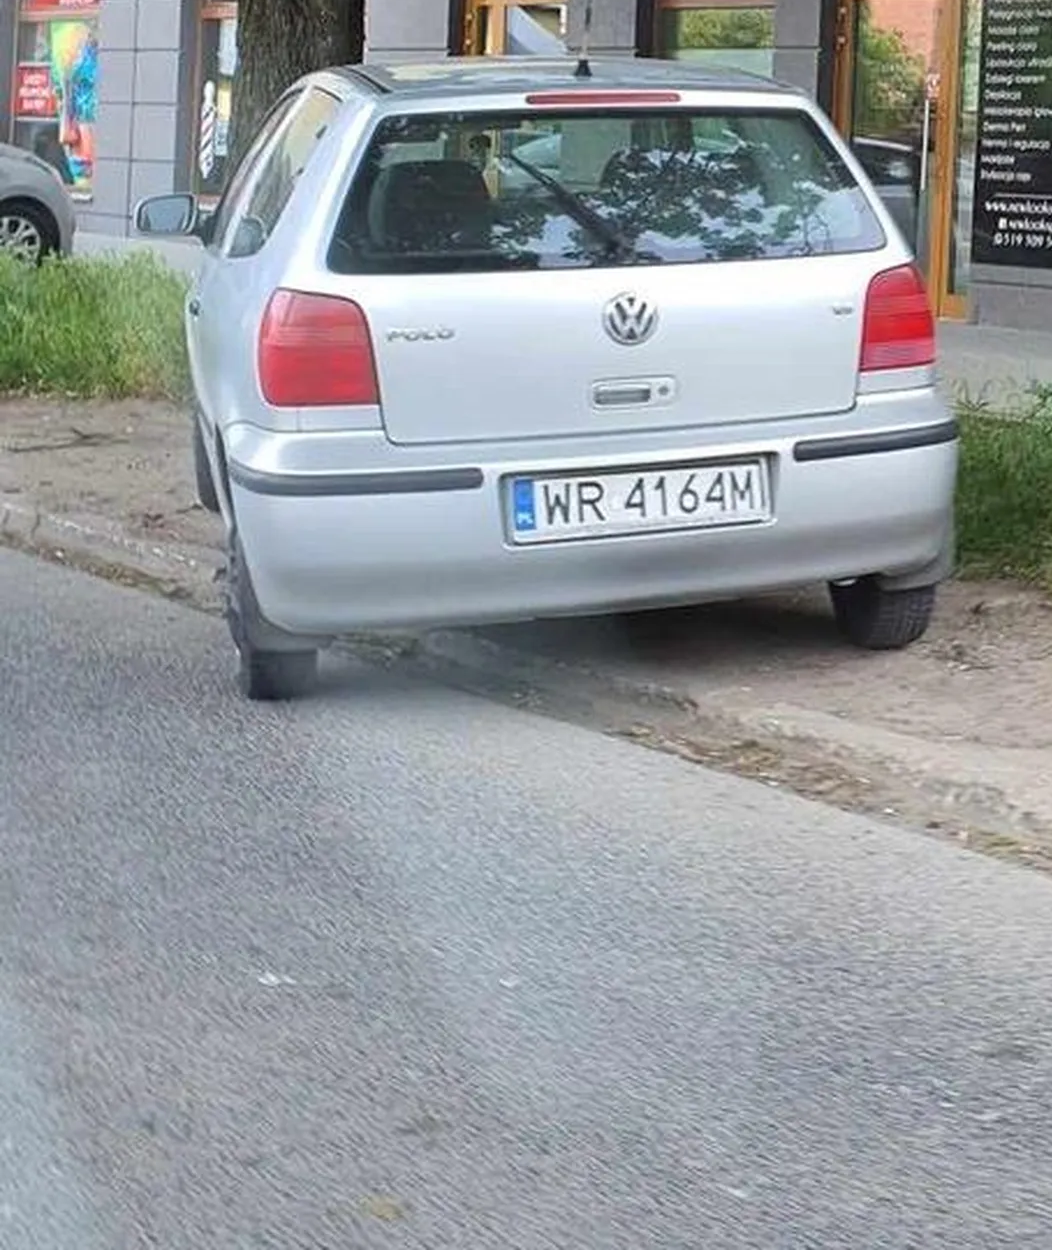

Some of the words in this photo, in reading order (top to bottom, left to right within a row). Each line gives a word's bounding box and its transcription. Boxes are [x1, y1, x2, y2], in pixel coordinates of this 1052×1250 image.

[386, 328, 456, 343] POLO
[543, 480, 607, 526] WR
[624, 470, 755, 519] 4164M
